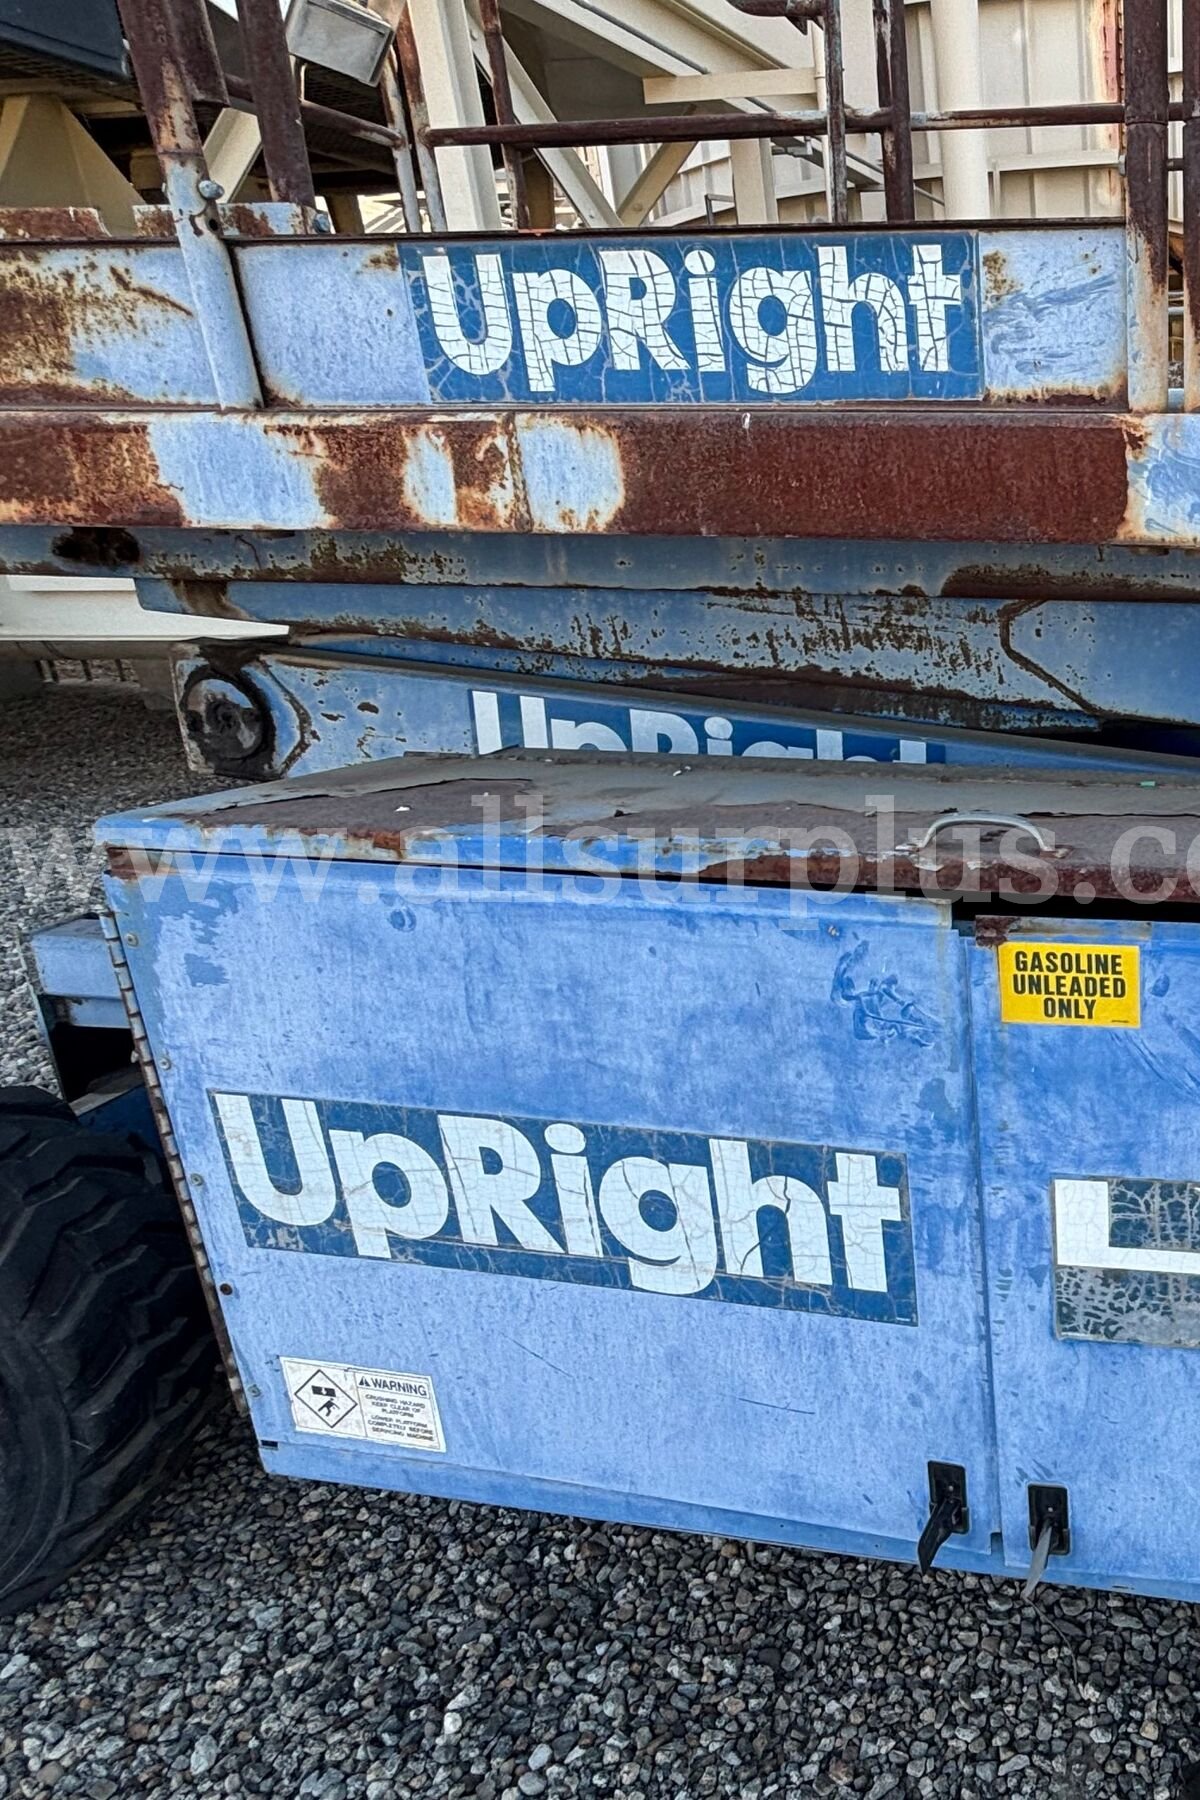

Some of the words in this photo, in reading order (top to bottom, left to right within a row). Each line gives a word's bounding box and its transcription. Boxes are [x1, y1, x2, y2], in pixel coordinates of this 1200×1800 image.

[422, 244, 962, 394] UpRight
[1015, 951, 1122, 975] GASOLINE
[1013, 974, 1126, 998] UNLEADED
[1043, 997, 1096, 1019] ONLY
[216, 1094, 902, 1295] UpRight
[370, 1377, 427, 1396] WARNING
